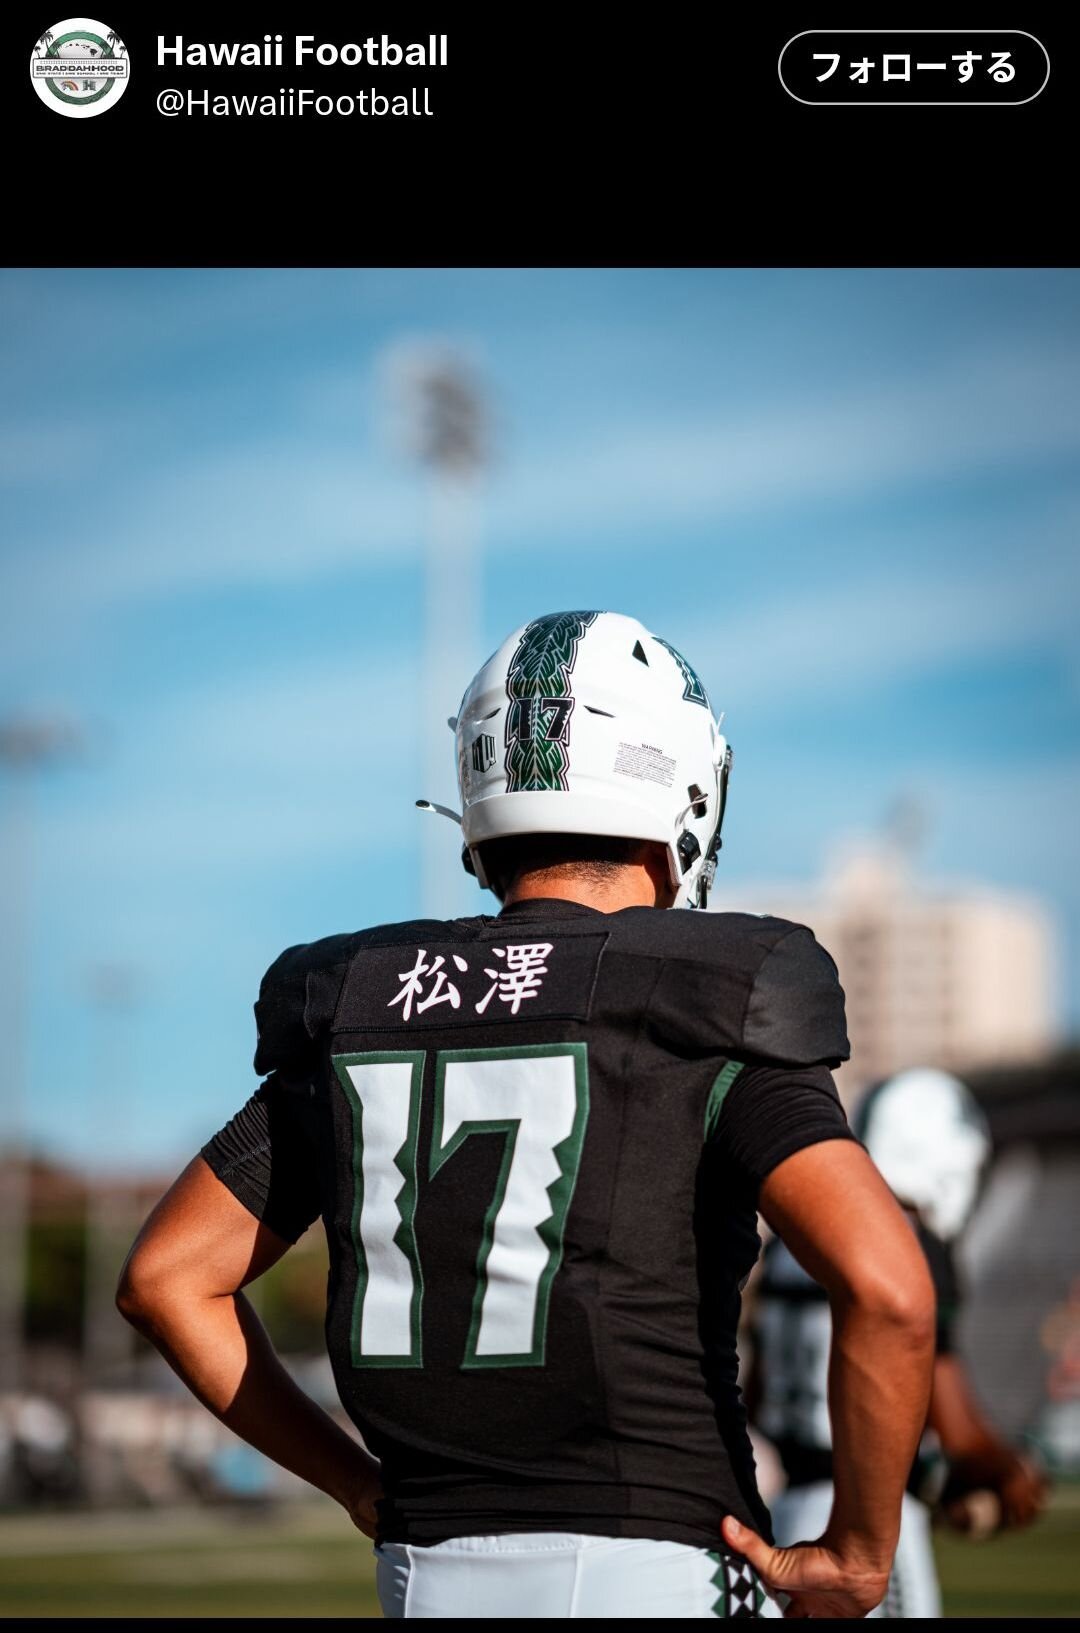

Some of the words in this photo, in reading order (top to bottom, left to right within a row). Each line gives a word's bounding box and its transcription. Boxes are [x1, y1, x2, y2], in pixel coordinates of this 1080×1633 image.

[515, 696, 575, 741] 17
[387, 942, 554, 1022] 松澤
[331, 1042, 590, 1370] 17
